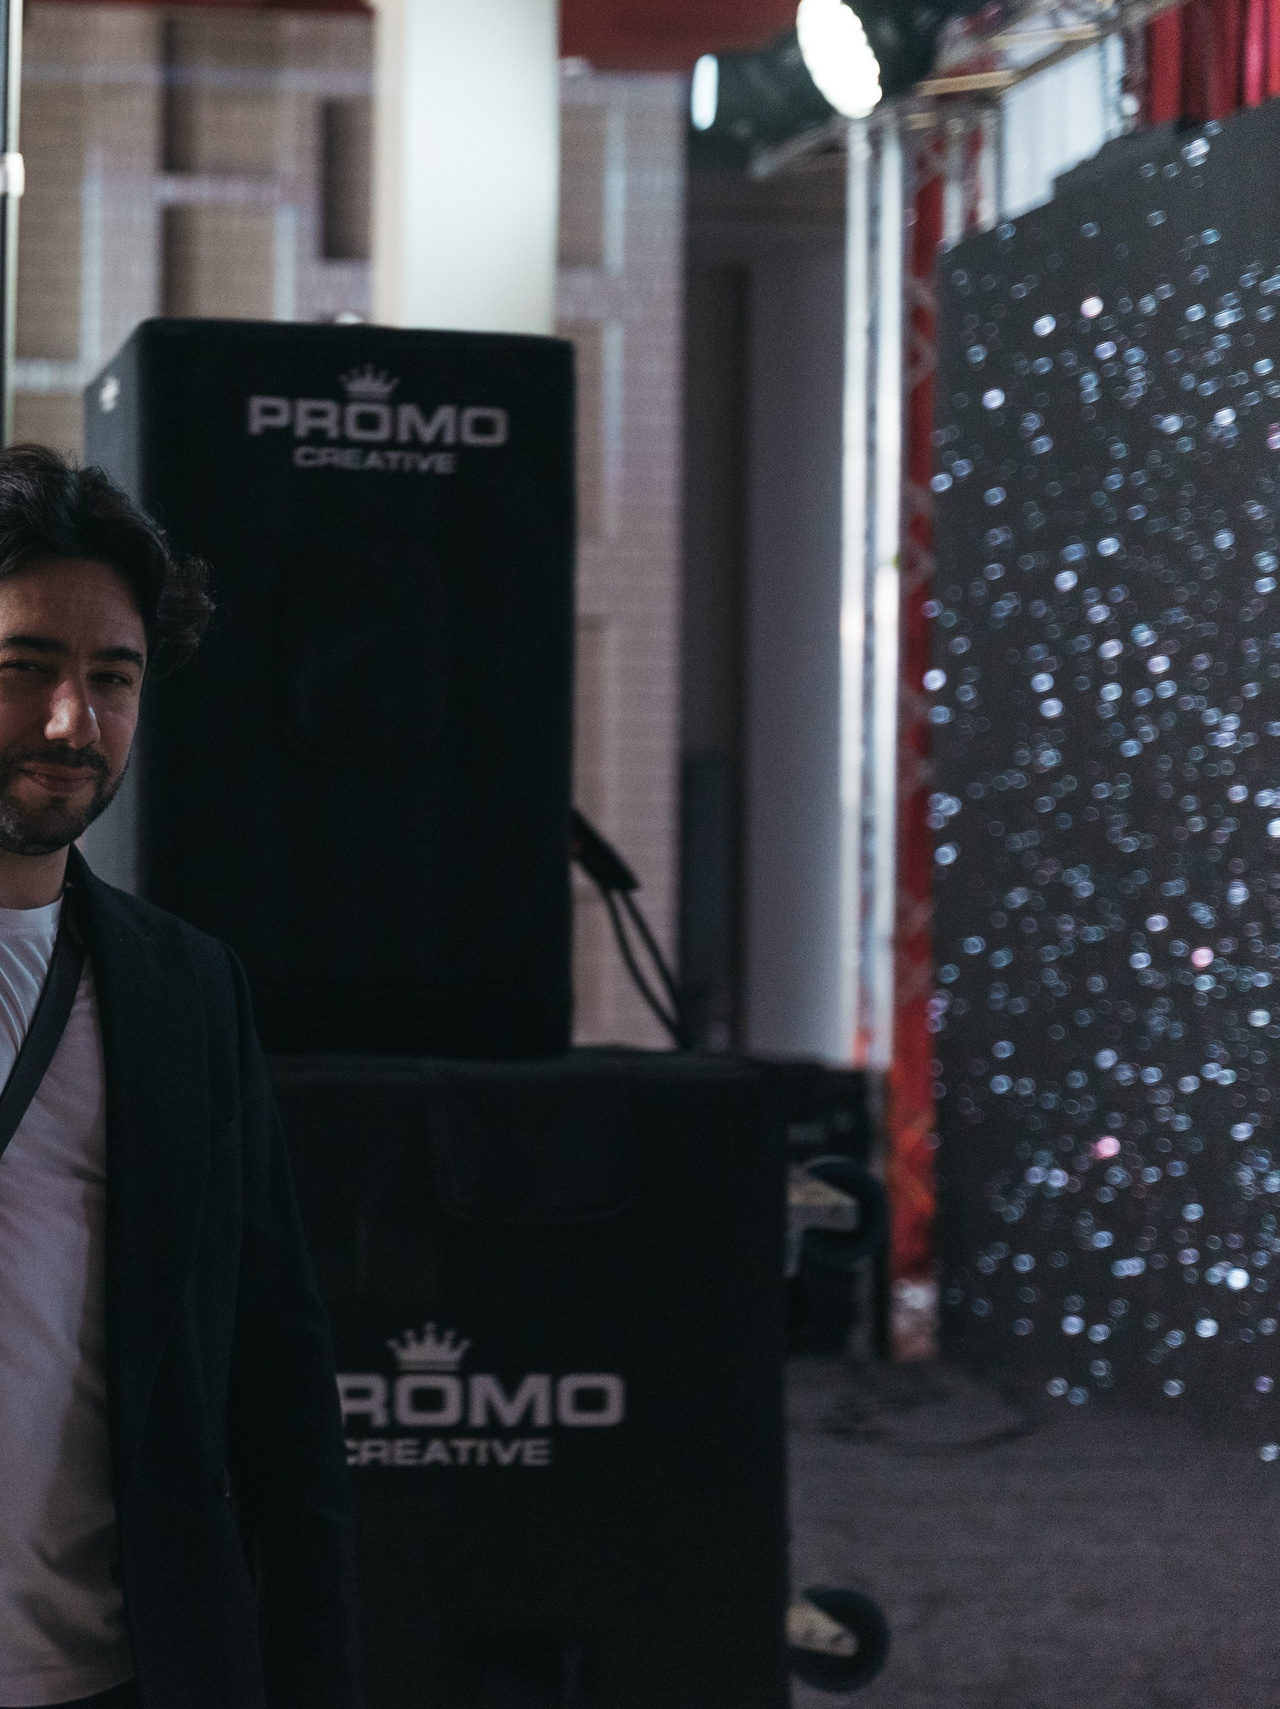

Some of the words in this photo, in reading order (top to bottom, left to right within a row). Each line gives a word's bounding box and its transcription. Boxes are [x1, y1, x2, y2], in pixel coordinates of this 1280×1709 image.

[247, 396, 508, 446] PROMO
[292, 446, 456, 475] CREATIVE
[335, 1372, 626, 1428] ROMO
